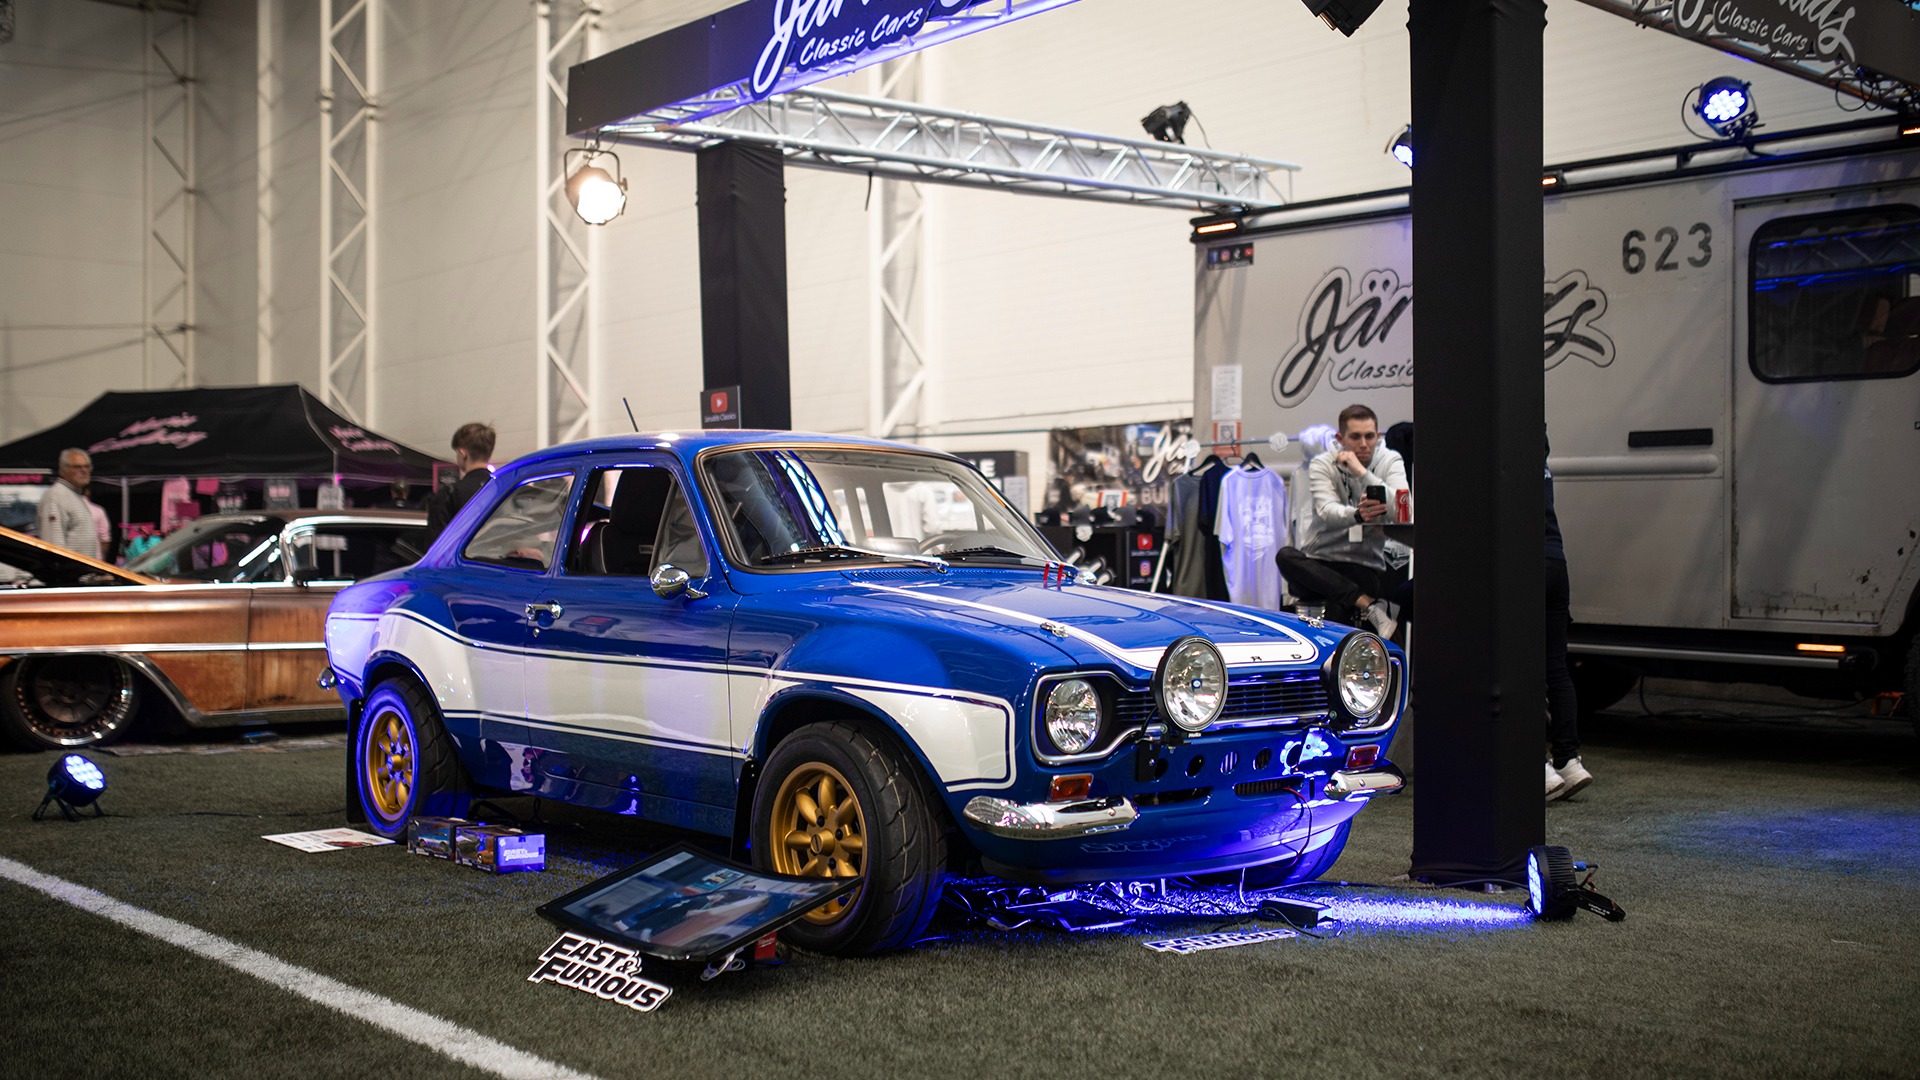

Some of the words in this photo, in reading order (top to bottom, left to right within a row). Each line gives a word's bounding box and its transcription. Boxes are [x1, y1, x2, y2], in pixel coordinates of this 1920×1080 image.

[800, 27, 866, 66] Classic
[870, 7, 924, 43] Cars
[1717, 0, 1769, 38] Classic
[1771, 22, 1808, 51] Cars
[1622, 221, 1712, 275] 623
[542, 934, 630, 969] FAST
[615, 959, 636, 974] &
[532, 955, 666, 1008] FURIOUS
